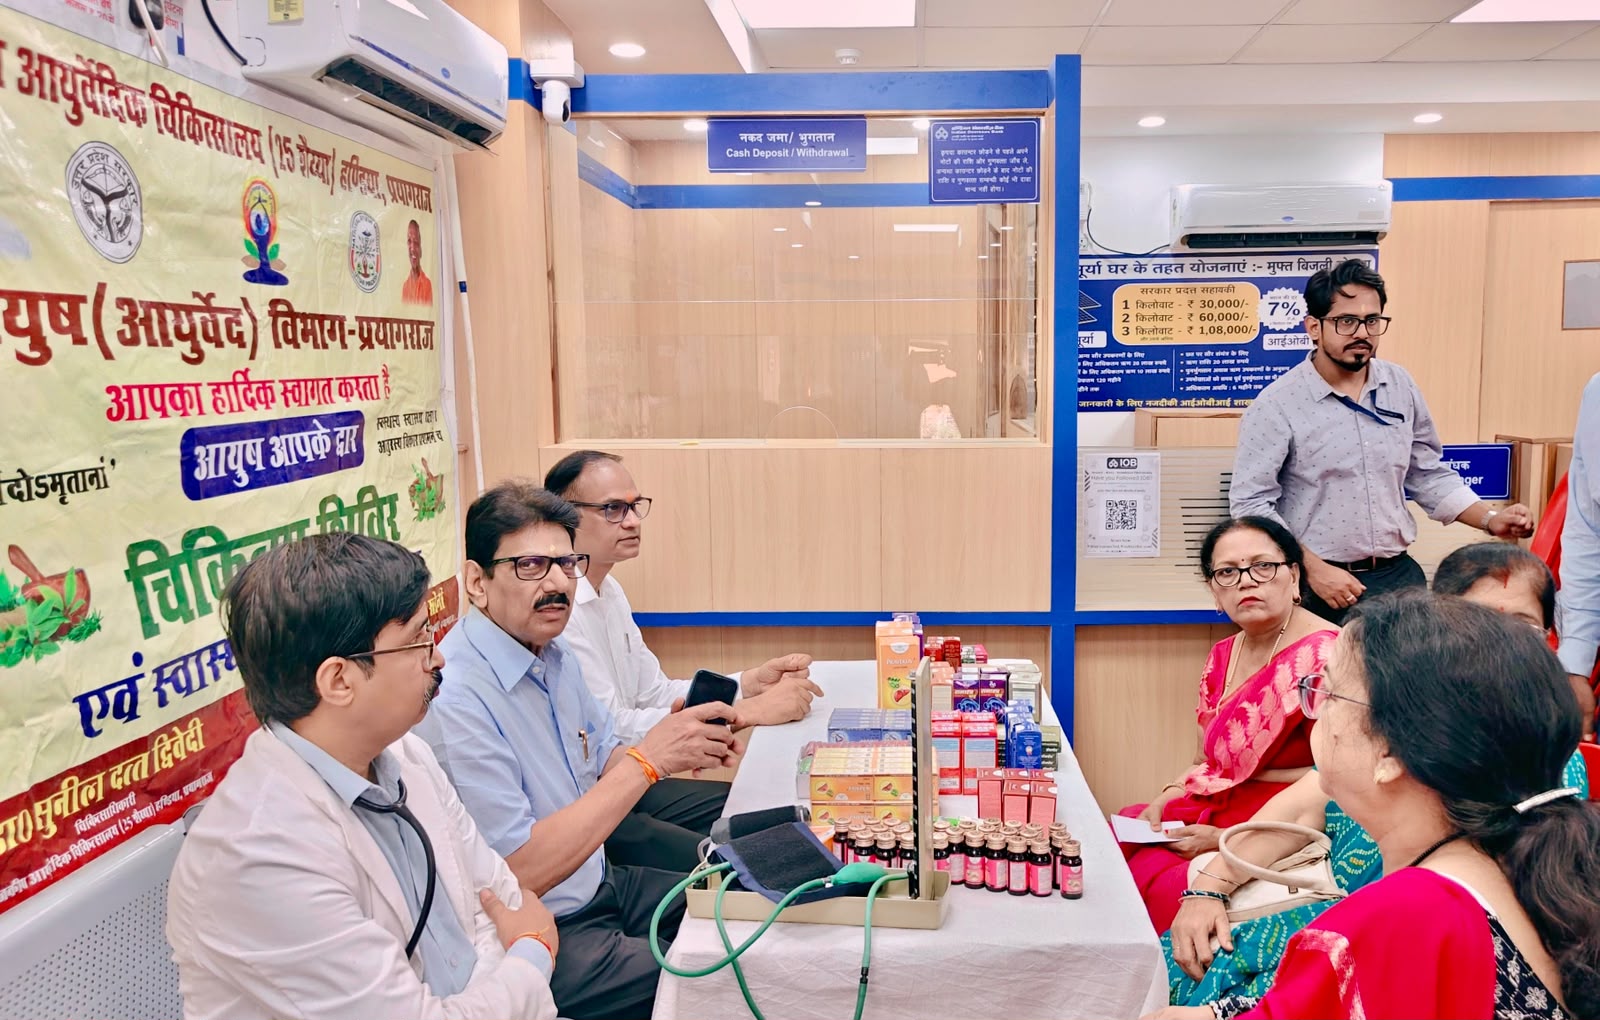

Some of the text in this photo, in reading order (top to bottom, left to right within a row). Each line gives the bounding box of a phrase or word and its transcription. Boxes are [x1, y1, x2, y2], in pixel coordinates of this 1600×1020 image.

[739, 131, 835, 147] नकद जमा/ भुगतान
[151, 82, 264, 164] चिकित्सालय
[386, 175, 433, 214] प्रयागराज
[726, 147, 750, 158] Cash
[752, 147, 789, 160] Deposit
[797, 147, 849, 158] Withdrawal
[87, 149, 109, 164] प्रदेश
[114, 160, 139, 207] सरकार
[1108, 264, 1127, 274] घर
[1134, 261, 1148, 274] के
[1153, 263, 1185, 275] तहत
[1190, 259, 1247, 274] योजनाएं
[1267, 261, 1293, 275] मुफ्त
[1297, 257, 1333, 272] बिजली
[1140, 287, 1197, 295] सरकार प्रदत्त
[1122, 299, 1249, 310] 1 किलोवाट ₹ 30,000/-
[1268, 301, 1300, 316] 7%
[1122, 312, 1249, 323] 2 किलोवाट ₹ 60,000/-
[0, 289, 88, 366] युष
[1122, 325, 1257, 337] 3 किलोवाट ₹ 1,08,000/-
[1267, 335, 1310, 347] आईओबी
[105, 363, 390, 422] आपका हार्दिक स्वागत करता है
[1079, 397, 1231, 407] जानकारी के लिए नजदीकी आईओबीआई
[194, 419, 360, 488] आयुष आपके द्वार
[1120, 458, 1137, 467] IOB
[73, 651, 145, 738] एवं
[34, 774, 104, 839] सुनील
[110, 754, 150, 789] दत्त
[152, 717, 205, 774] द्विवेदी
[74, 791, 136, 835] चिकित्साधिकारी
[69, 825, 119, 862] चिकित्सालय
